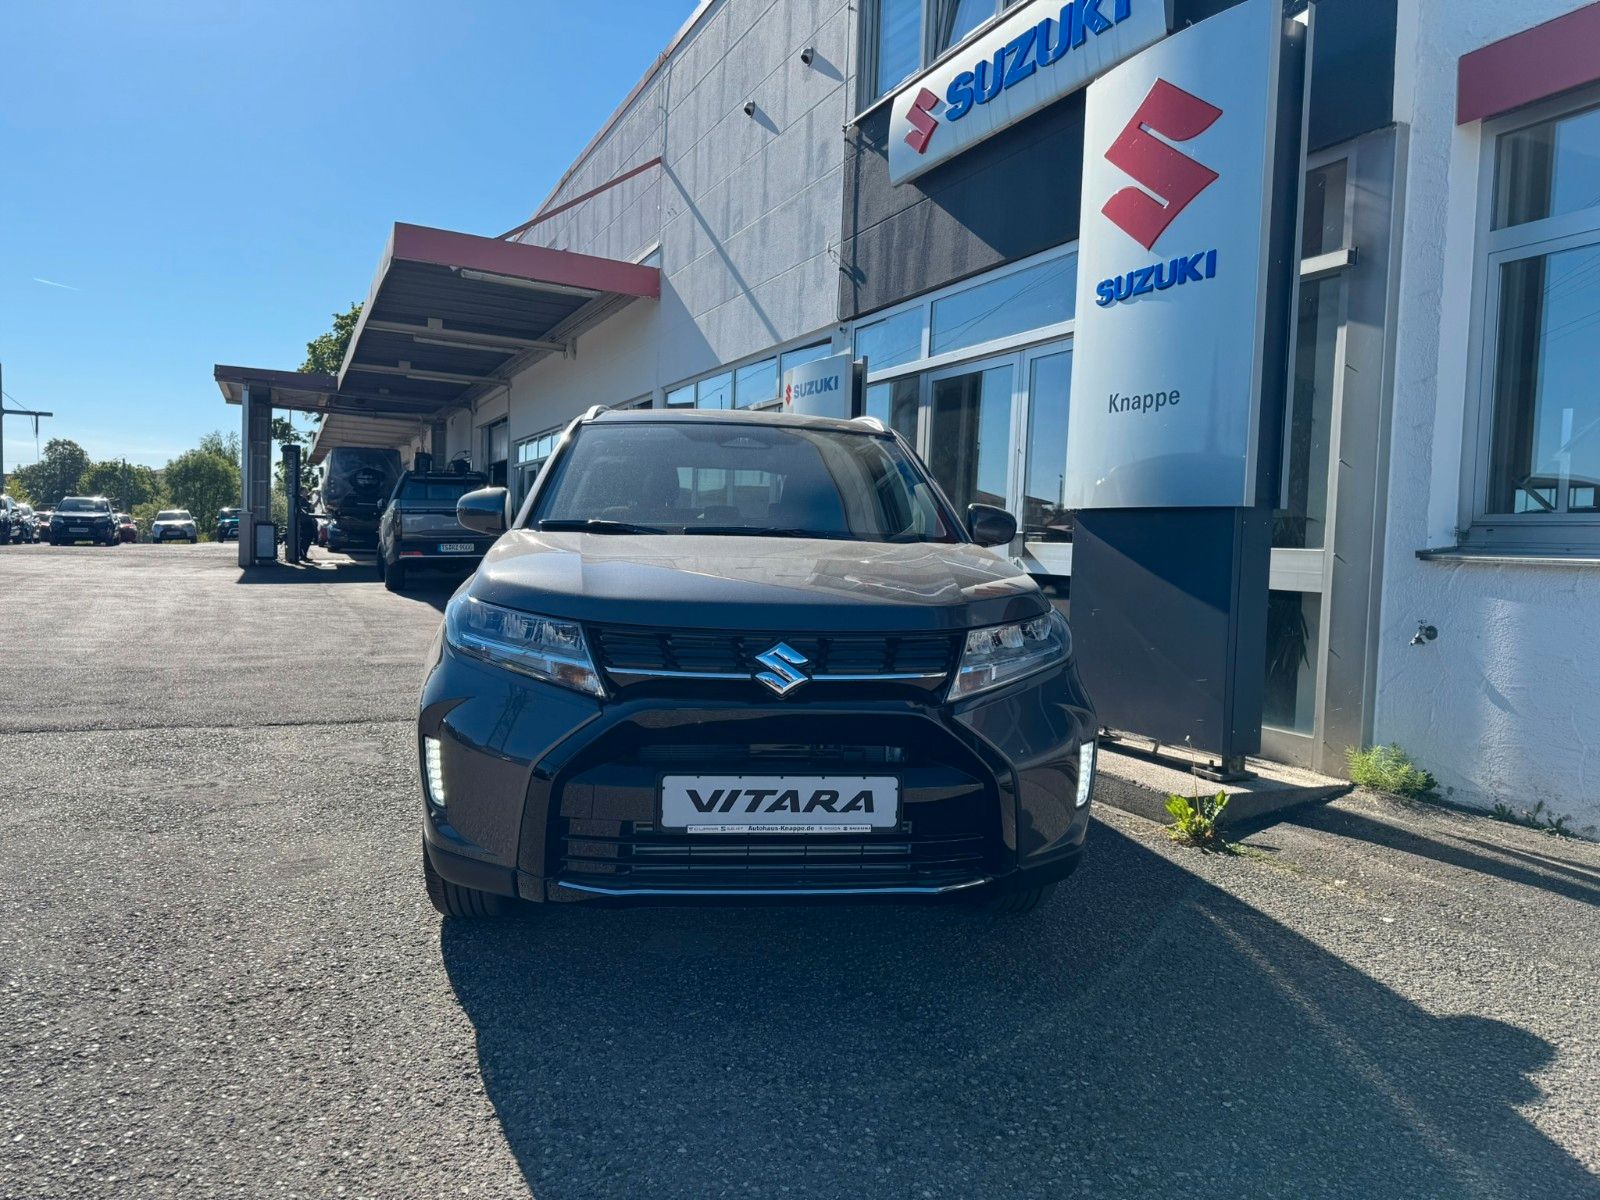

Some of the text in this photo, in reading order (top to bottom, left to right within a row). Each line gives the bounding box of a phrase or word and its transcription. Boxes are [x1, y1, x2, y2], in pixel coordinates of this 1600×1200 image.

[1095, 249, 1217, 307] SUZUKI
[793, 375, 839, 399] SUZUKI
[1108, 389, 1181, 414] Knappe
[686, 789, 875, 813] VITARA
